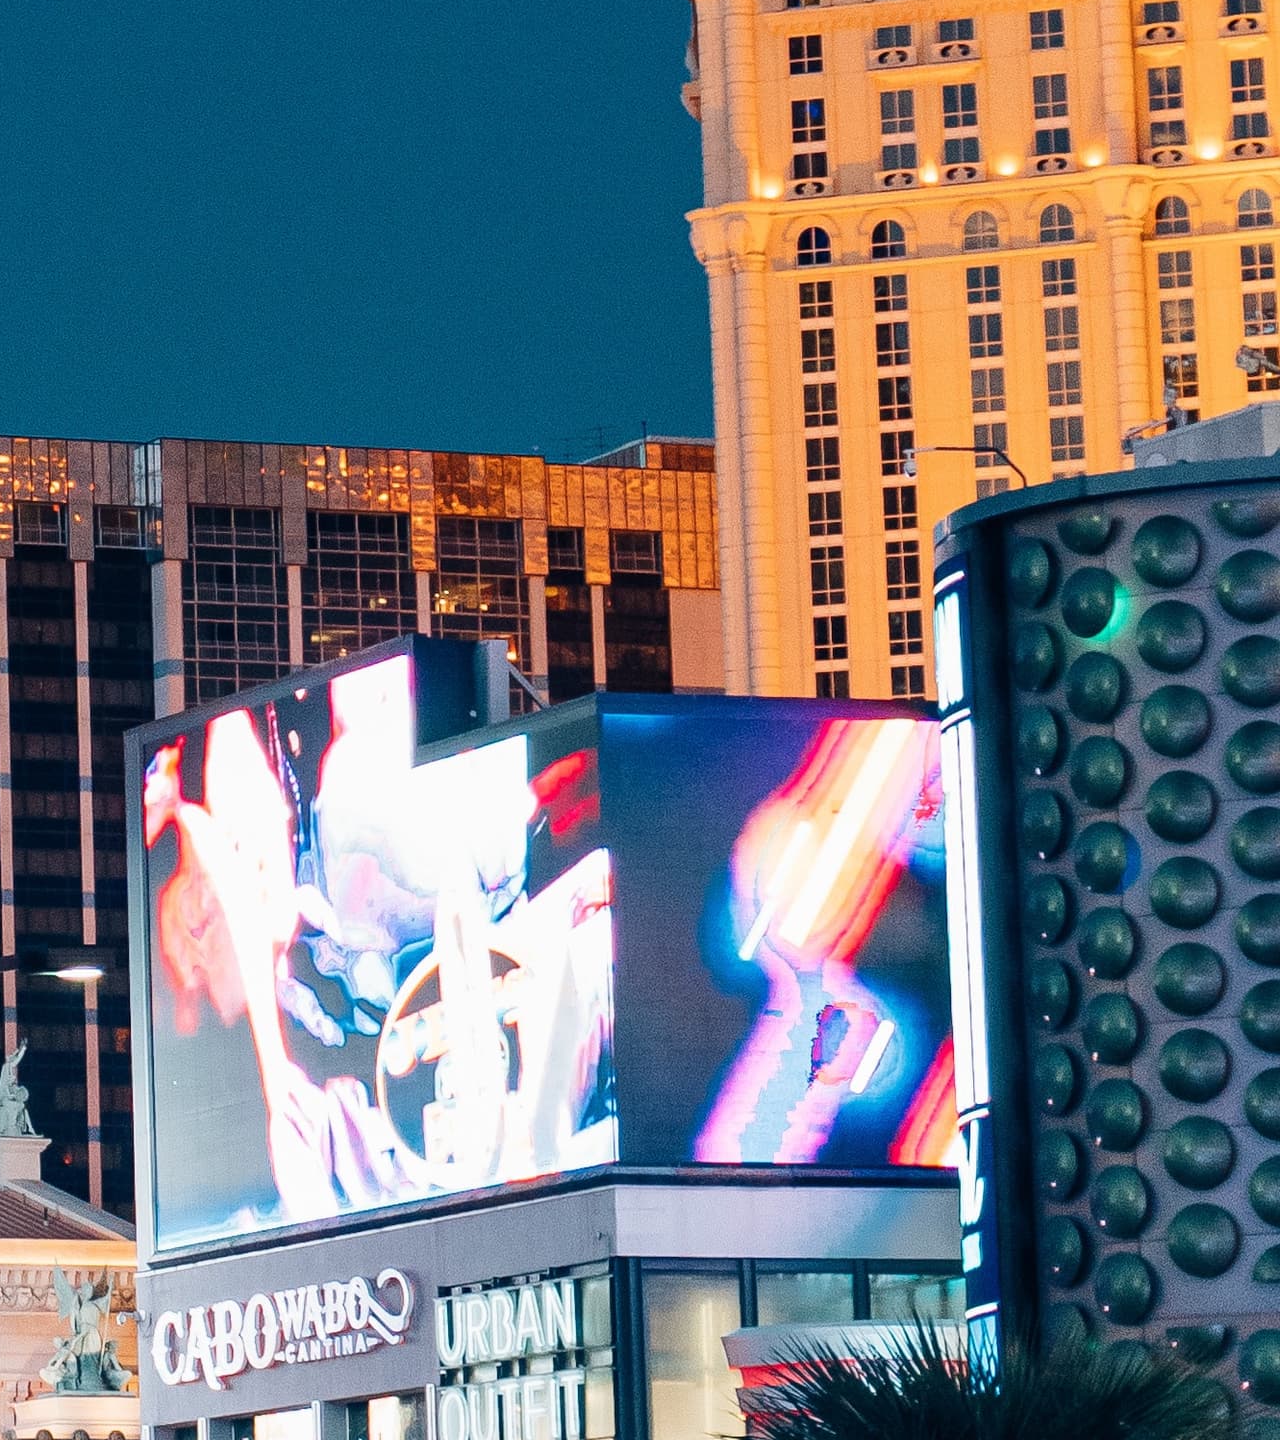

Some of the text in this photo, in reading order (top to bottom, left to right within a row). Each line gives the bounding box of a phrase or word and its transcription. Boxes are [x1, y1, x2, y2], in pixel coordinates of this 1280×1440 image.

[151, 1268, 410, 1391] CABO WABO
[285, 1333, 368, 1364] CANTINA
[435, 1279, 577, 1366] URBAN
